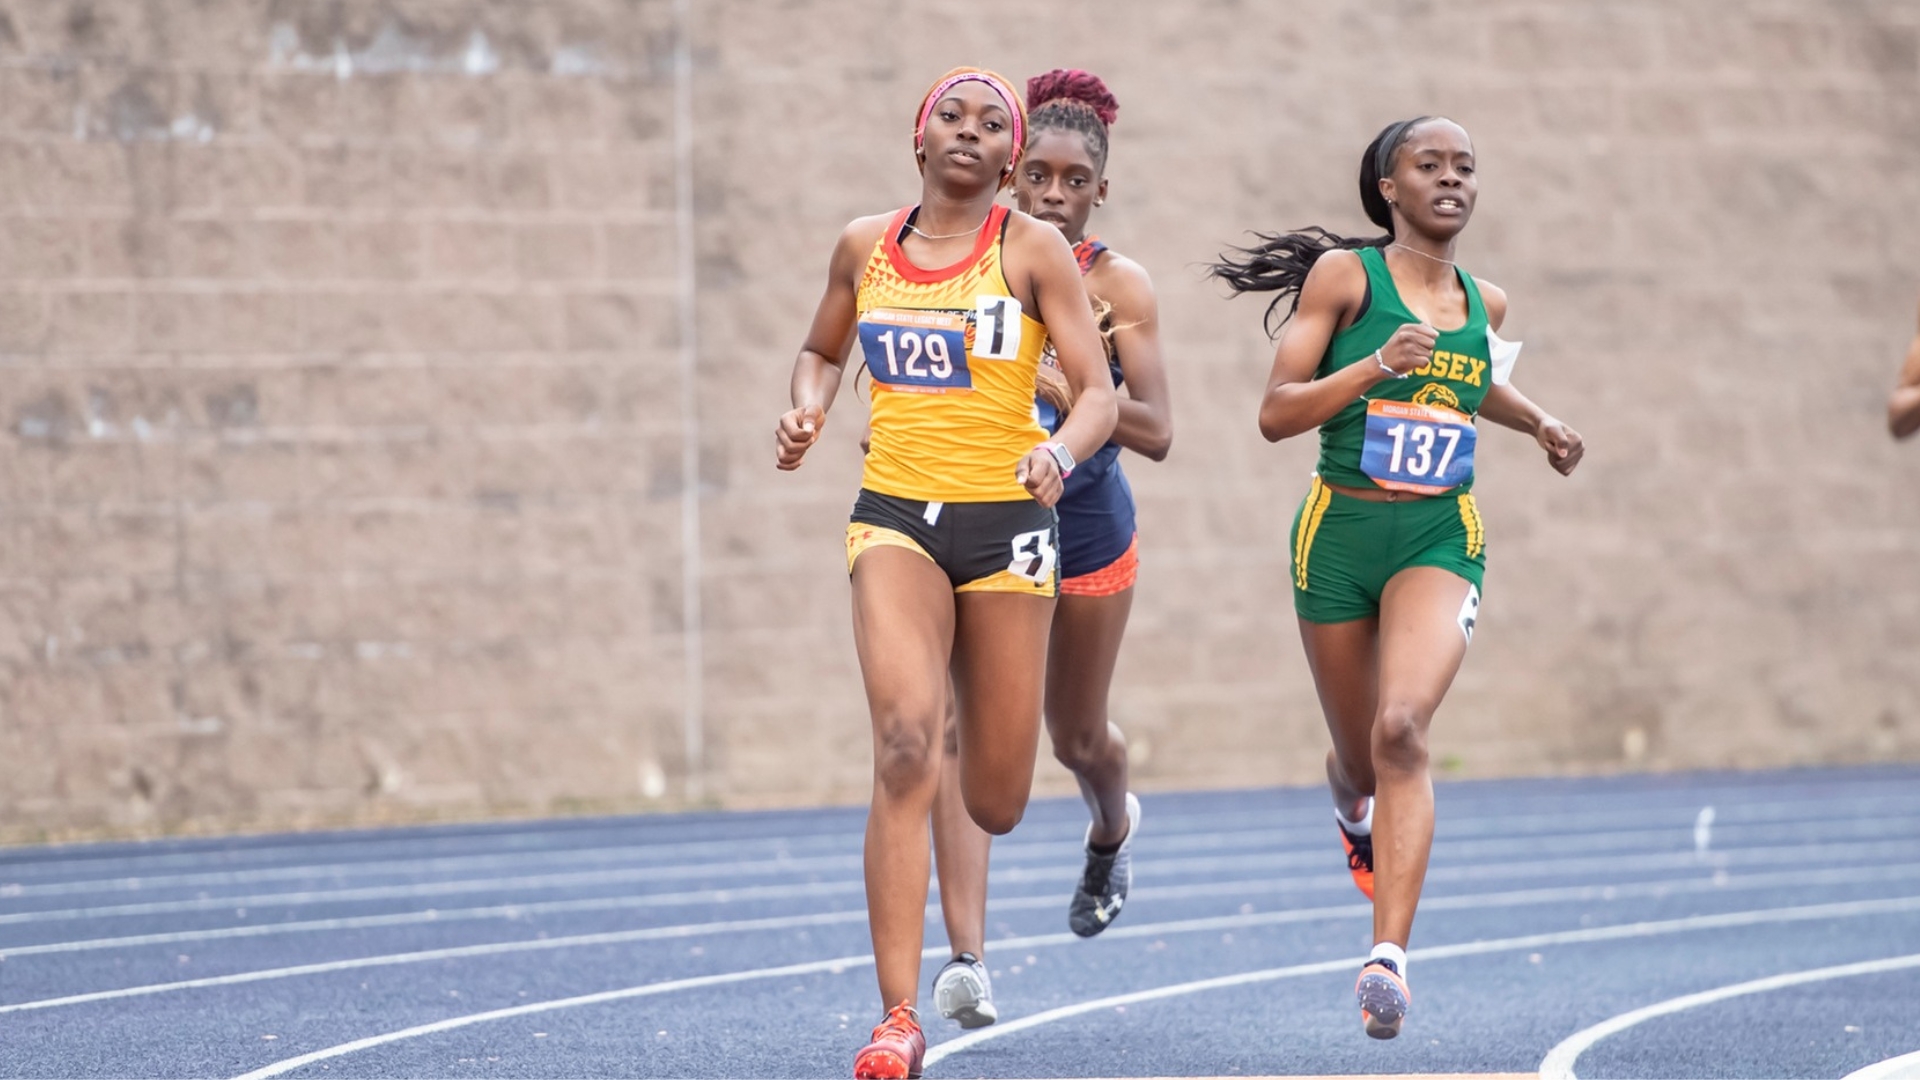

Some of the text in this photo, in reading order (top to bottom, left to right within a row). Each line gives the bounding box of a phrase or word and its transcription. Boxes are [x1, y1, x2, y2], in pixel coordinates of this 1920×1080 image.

[984, 300, 1005, 354] 1
[878, 331, 953, 379] 129
[1407, 350, 1486, 387] SEX
[1387, 423, 1461, 478] 137
